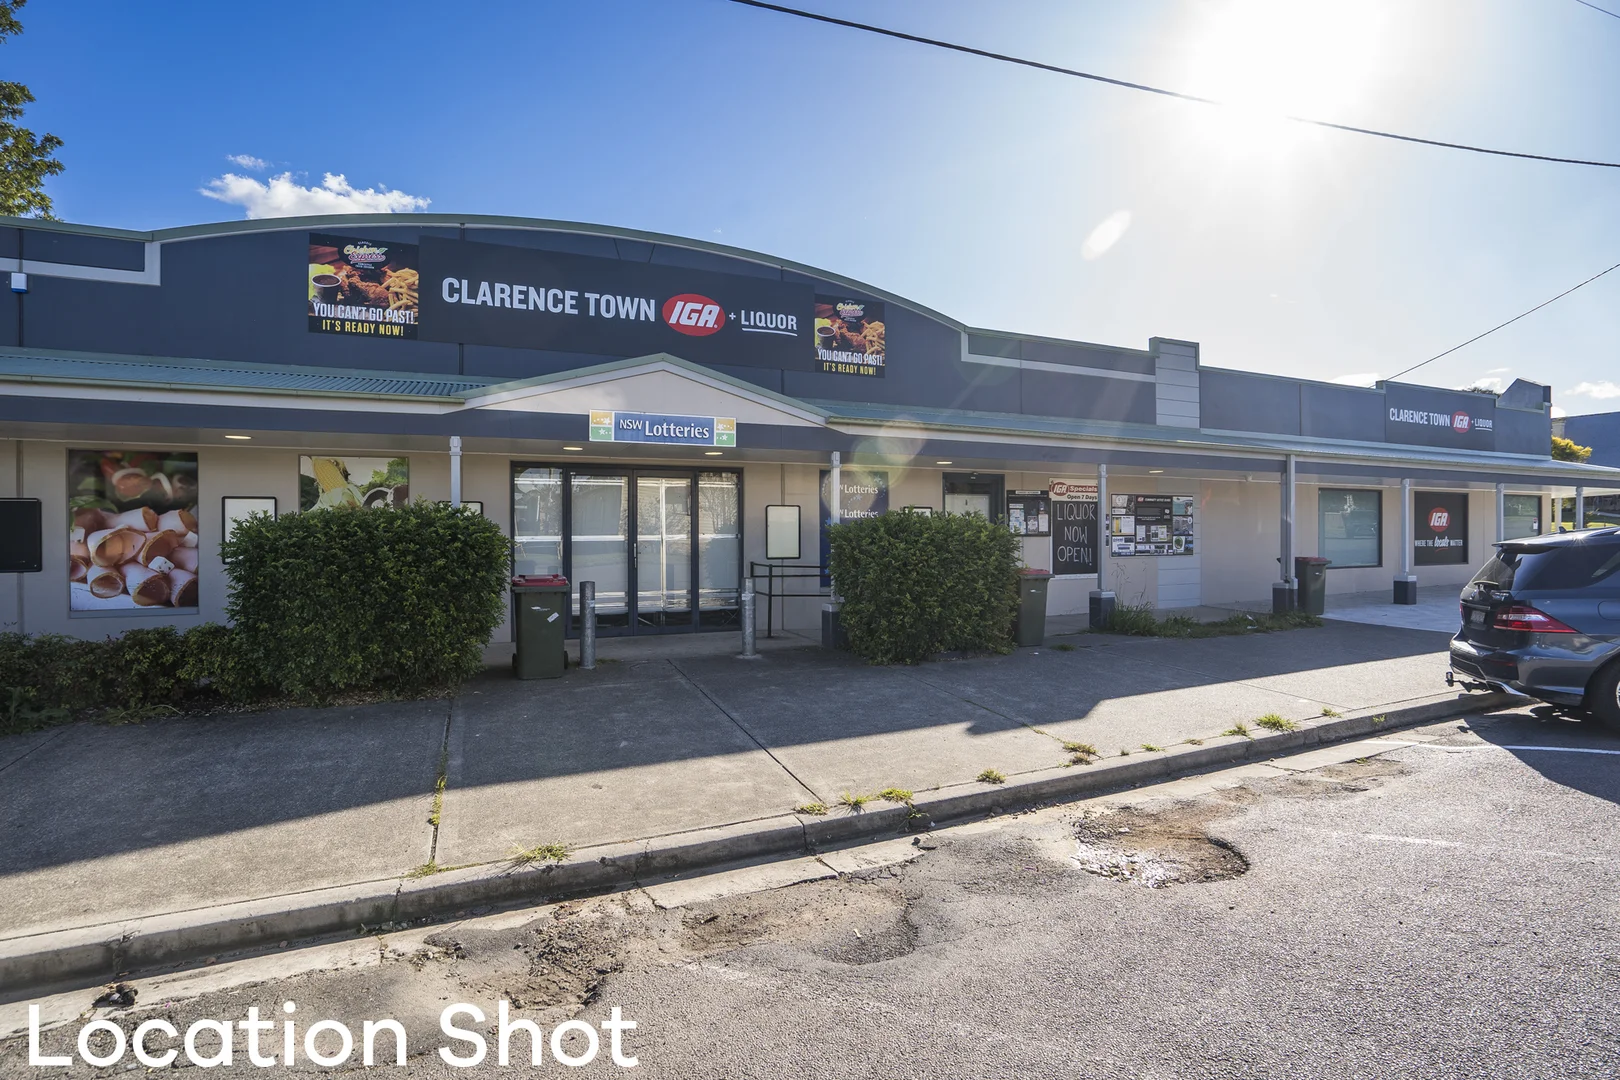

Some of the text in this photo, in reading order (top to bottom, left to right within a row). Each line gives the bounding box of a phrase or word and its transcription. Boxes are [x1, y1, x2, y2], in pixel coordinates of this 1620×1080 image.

[442, 277, 579, 315] CLARENCE
[585, 292, 656, 322] TOWN
[669, 300, 720, 328] IGA
[741, 309, 798, 331] LIQUOR
[313, 302, 414, 325] YOU CAN'T GO PAST!
[322, 319, 404, 337] IT'S READY NOW!
[817, 348, 883, 366] YOU CAN'T GO PAST!
[823, 362, 876, 376] IT'S READY NOW!
[1389, 407, 1428, 425] CLARENCE
[1429, 412, 1451, 427] TOWN
[1453, 415, 1469, 429] IGA
[1474, 418, 1493, 429] LIQUOR
[619, 418, 710, 439] NSW Lotteries
[844, 484, 879, 494] Lotteries
[1053, 483, 1098, 494] IGA Specials
[1056, 503, 1096, 521] LIQUOR
[1430, 512, 1449, 527] IGA
[1064, 525, 1088, 544] NOW
[1056, 545, 1093, 566] OPEN!
